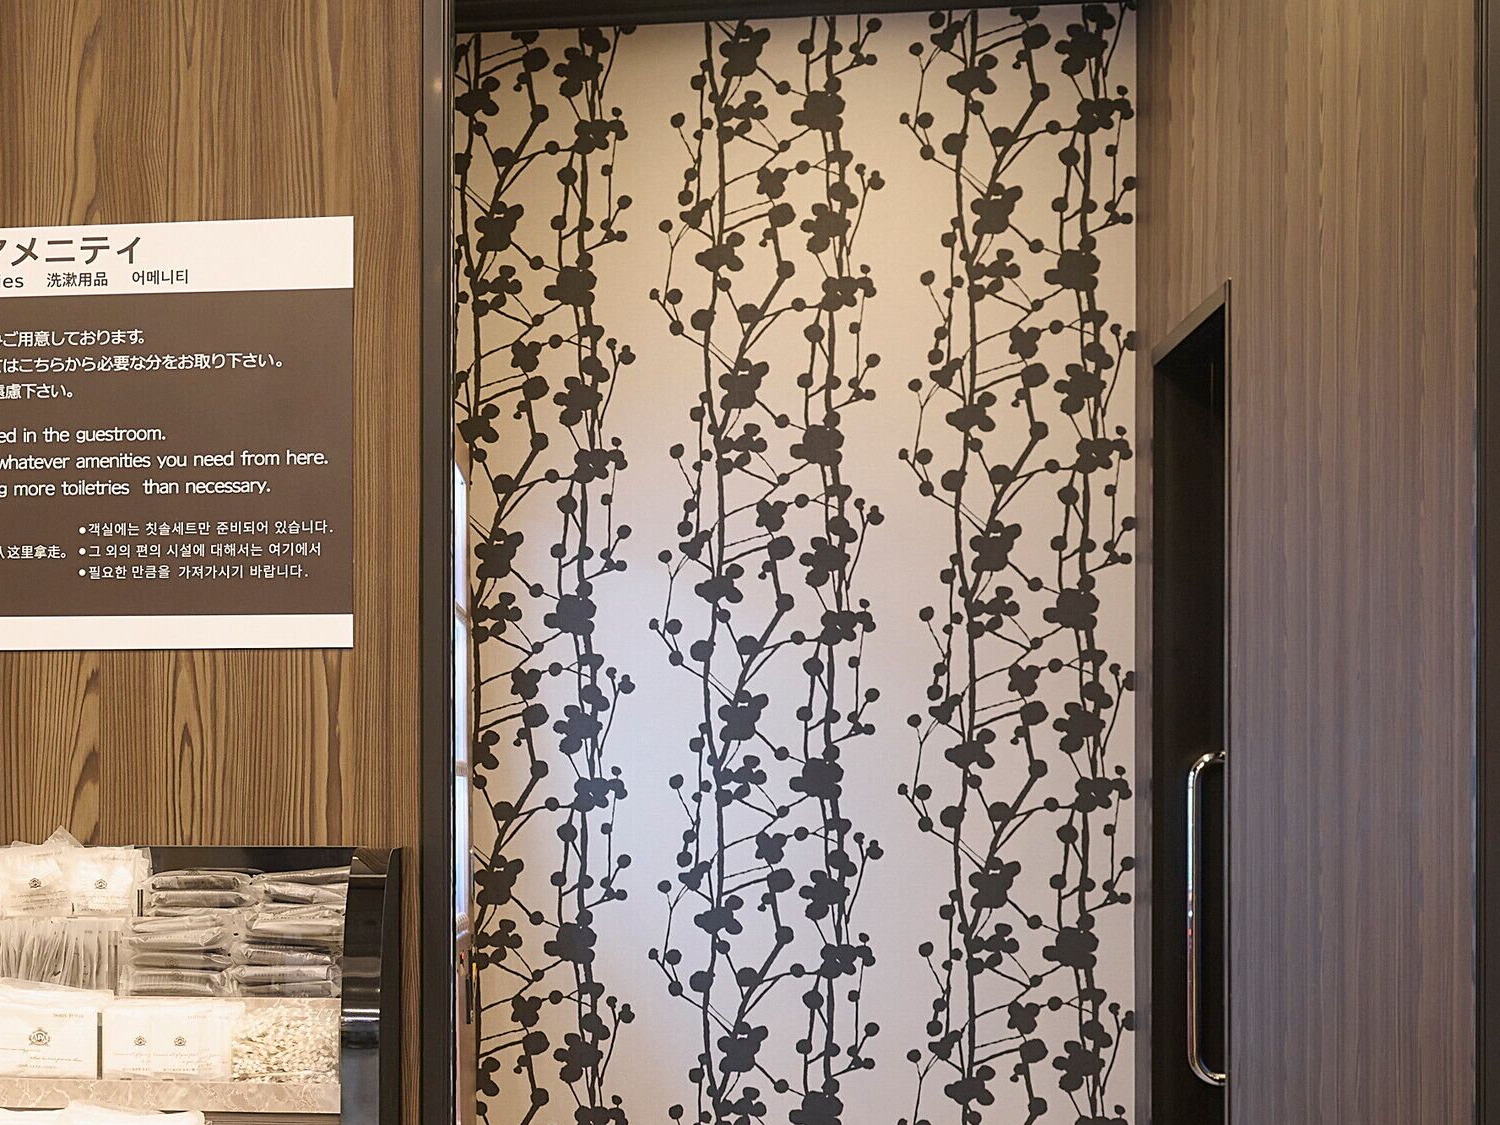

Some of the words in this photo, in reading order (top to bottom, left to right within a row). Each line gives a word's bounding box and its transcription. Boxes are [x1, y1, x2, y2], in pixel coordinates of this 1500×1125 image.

[46, 271, 108, 288] 洗漱用品
[131, 268, 189, 285] 어메니티
[23, 427, 37, 443] in
[42, 427, 70, 443] the
[76, 427, 166, 445] guestroom.
[76, 453, 151, 469] amenities
[157, 455, 187, 470] you
[193, 451, 235, 467] need
[240, 450, 280, 466] from
[286, 450, 329, 466] here.
[13, 483, 56, 497] more
[61, 480, 130, 496] toiletries
[142, 479, 180, 495] than
[185, 480, 271, 497] necessary.
[88, 523, 140, 537] 객실에는
[146, 522, 211, 536] 칫솔세트만
[216, 521, 269, 535] 준비되어
[274, 520, 334, 535] 있습니다.
[88, 545, 102, 557] 그
[105, 544, 131, 558] 외의
[135, 544, 161, 558] 편의
[166, 543, 205, 558] 시설에
[210, 542, 263, 557] 대해서는
[268, 542, 321, 557] 여기에서
[88, 566, 127, 580] 필요한
[131, 565, 171, 579] 만큼을
[178, 565, 244, 579] 가져가시기
[249, 564, 309, 579] 바랍니다.
